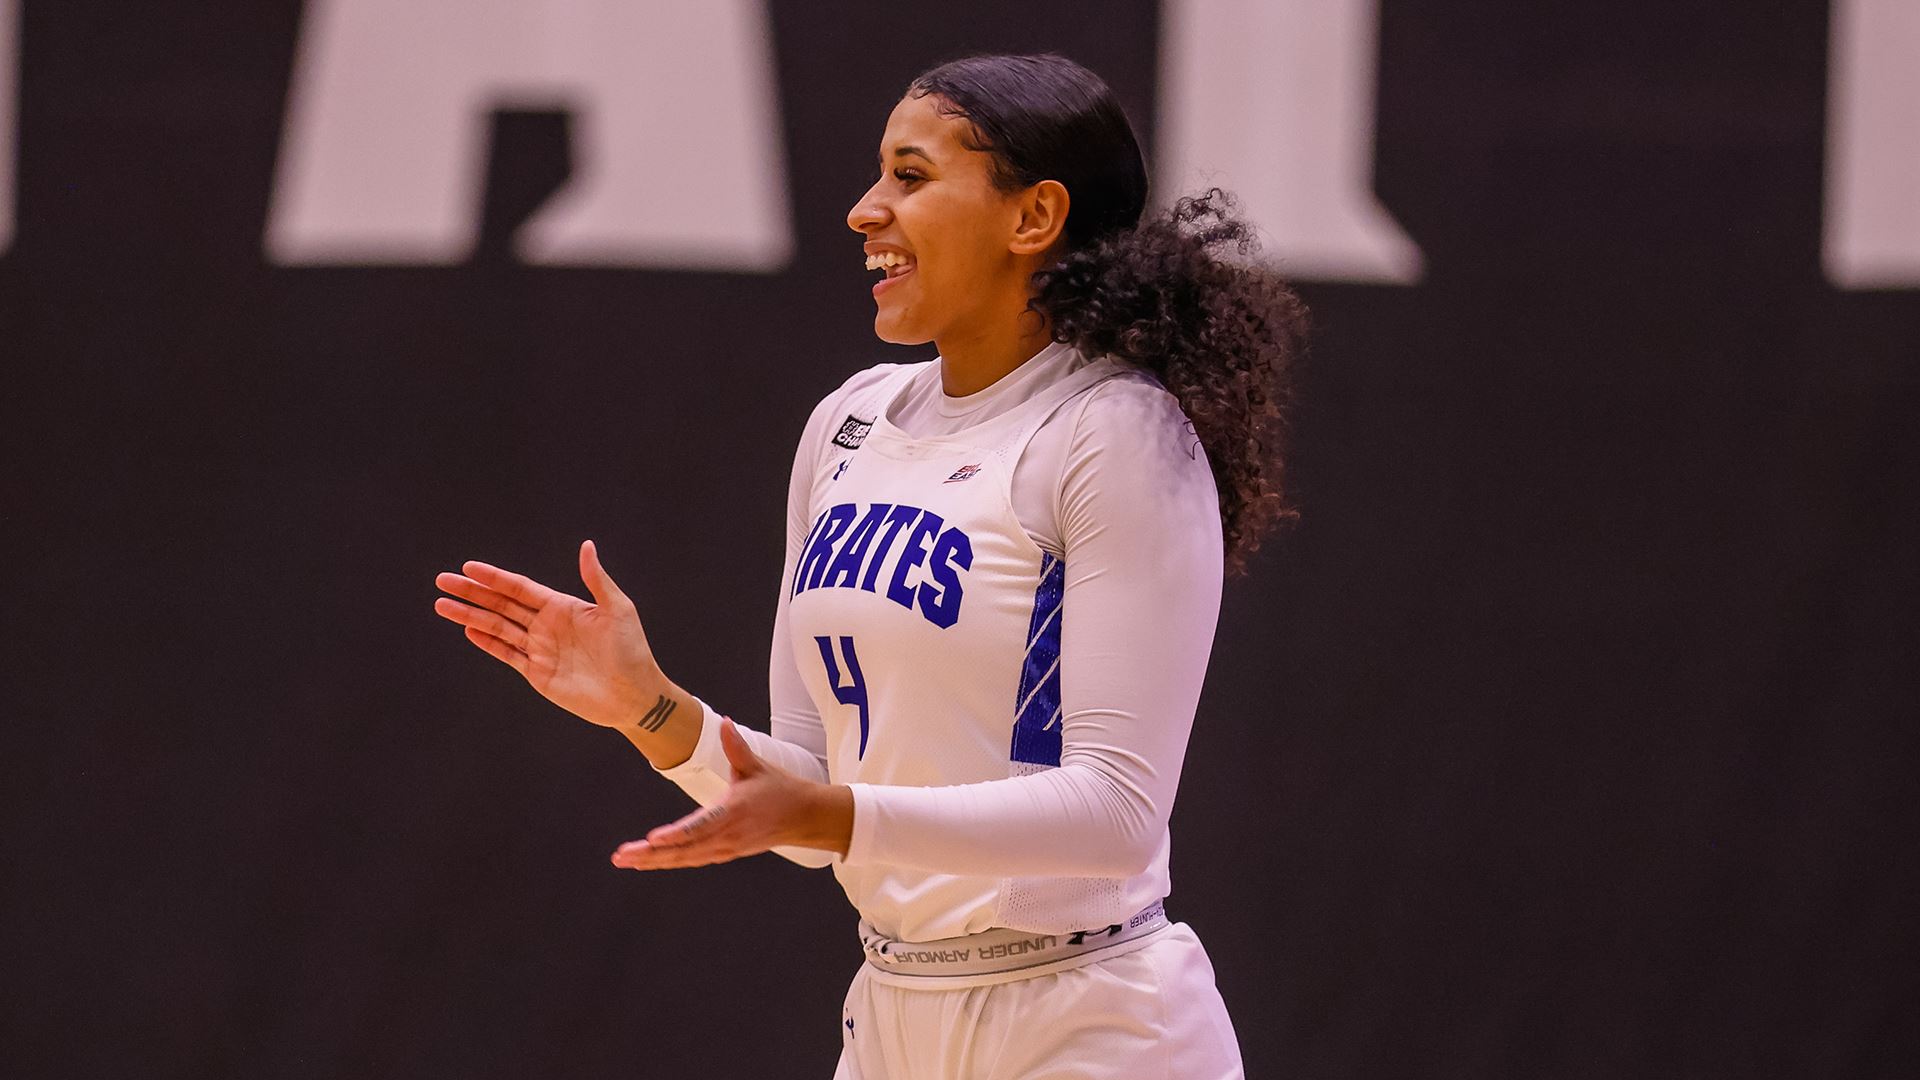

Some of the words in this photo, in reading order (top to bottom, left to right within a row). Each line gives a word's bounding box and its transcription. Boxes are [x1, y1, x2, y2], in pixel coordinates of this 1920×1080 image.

[789, 503, 974, 630] IRATES
[813, 635, 870, 762] 4
[893, 949, 970, 963] ARMOUR
[978, 935, 1057, 960] UNDER
